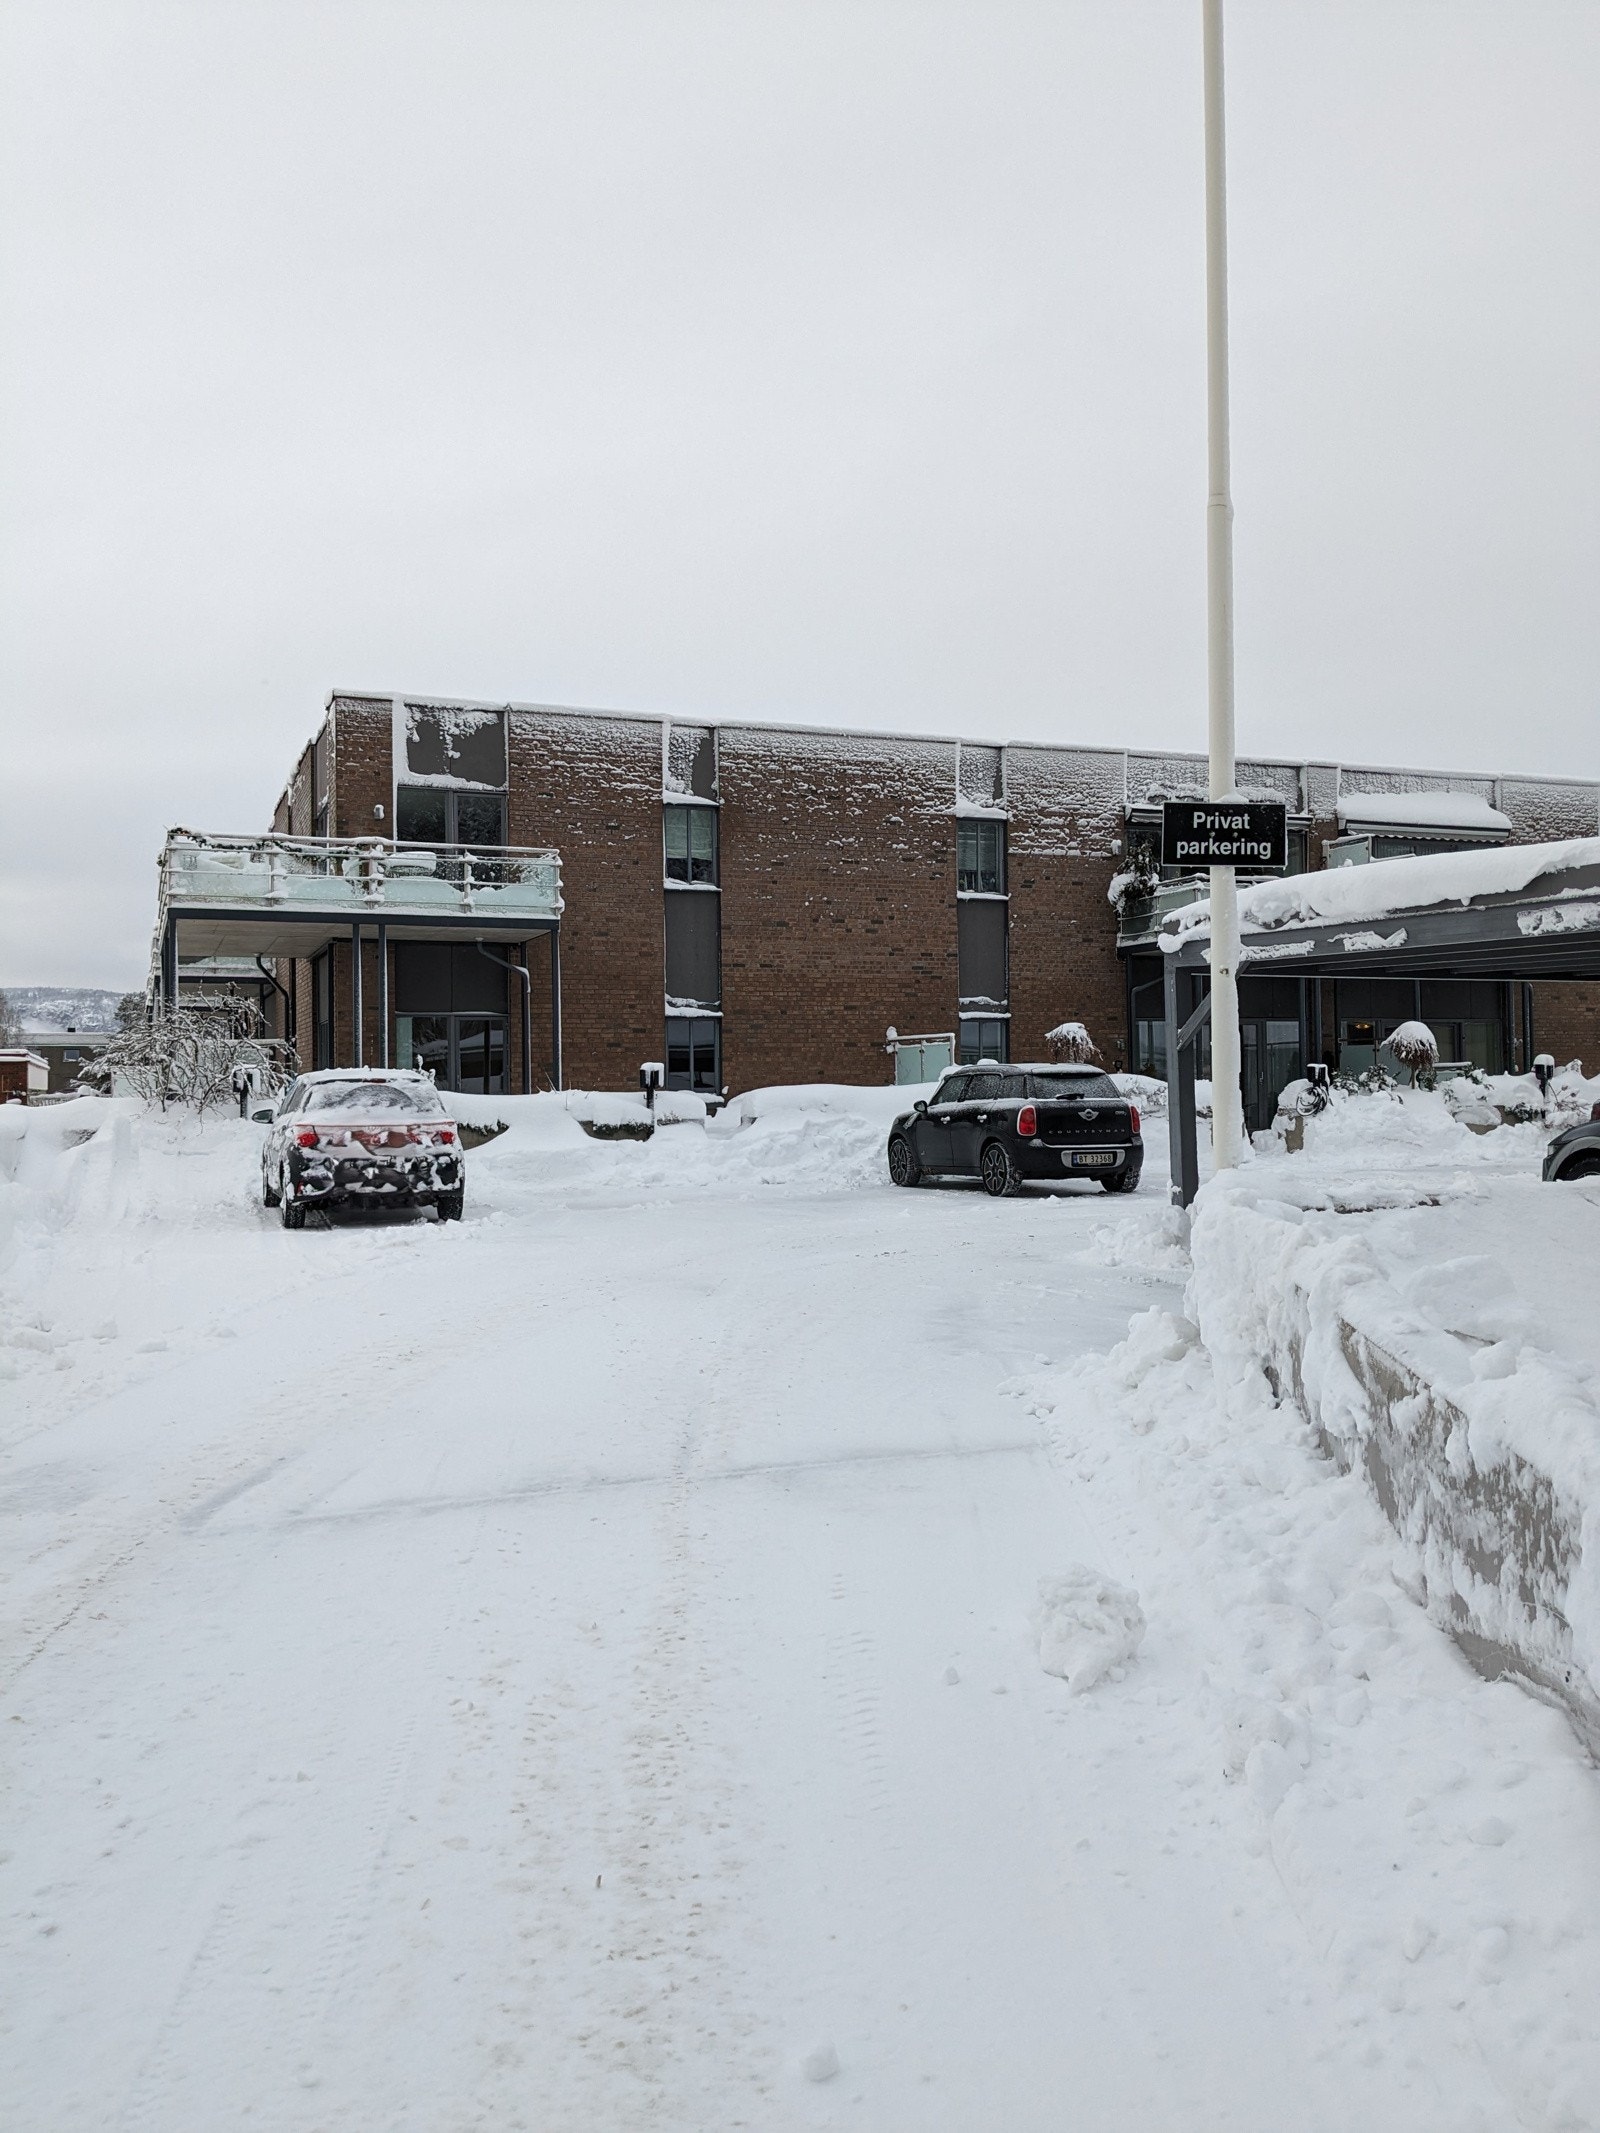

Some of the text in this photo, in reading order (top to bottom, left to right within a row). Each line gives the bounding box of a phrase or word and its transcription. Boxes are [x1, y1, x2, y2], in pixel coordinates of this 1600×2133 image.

[1193, 811, 1250, 829] Privat
[1176, 838, 1271, 860] parkering
[1078, 1155, 1088, 1163] BT
